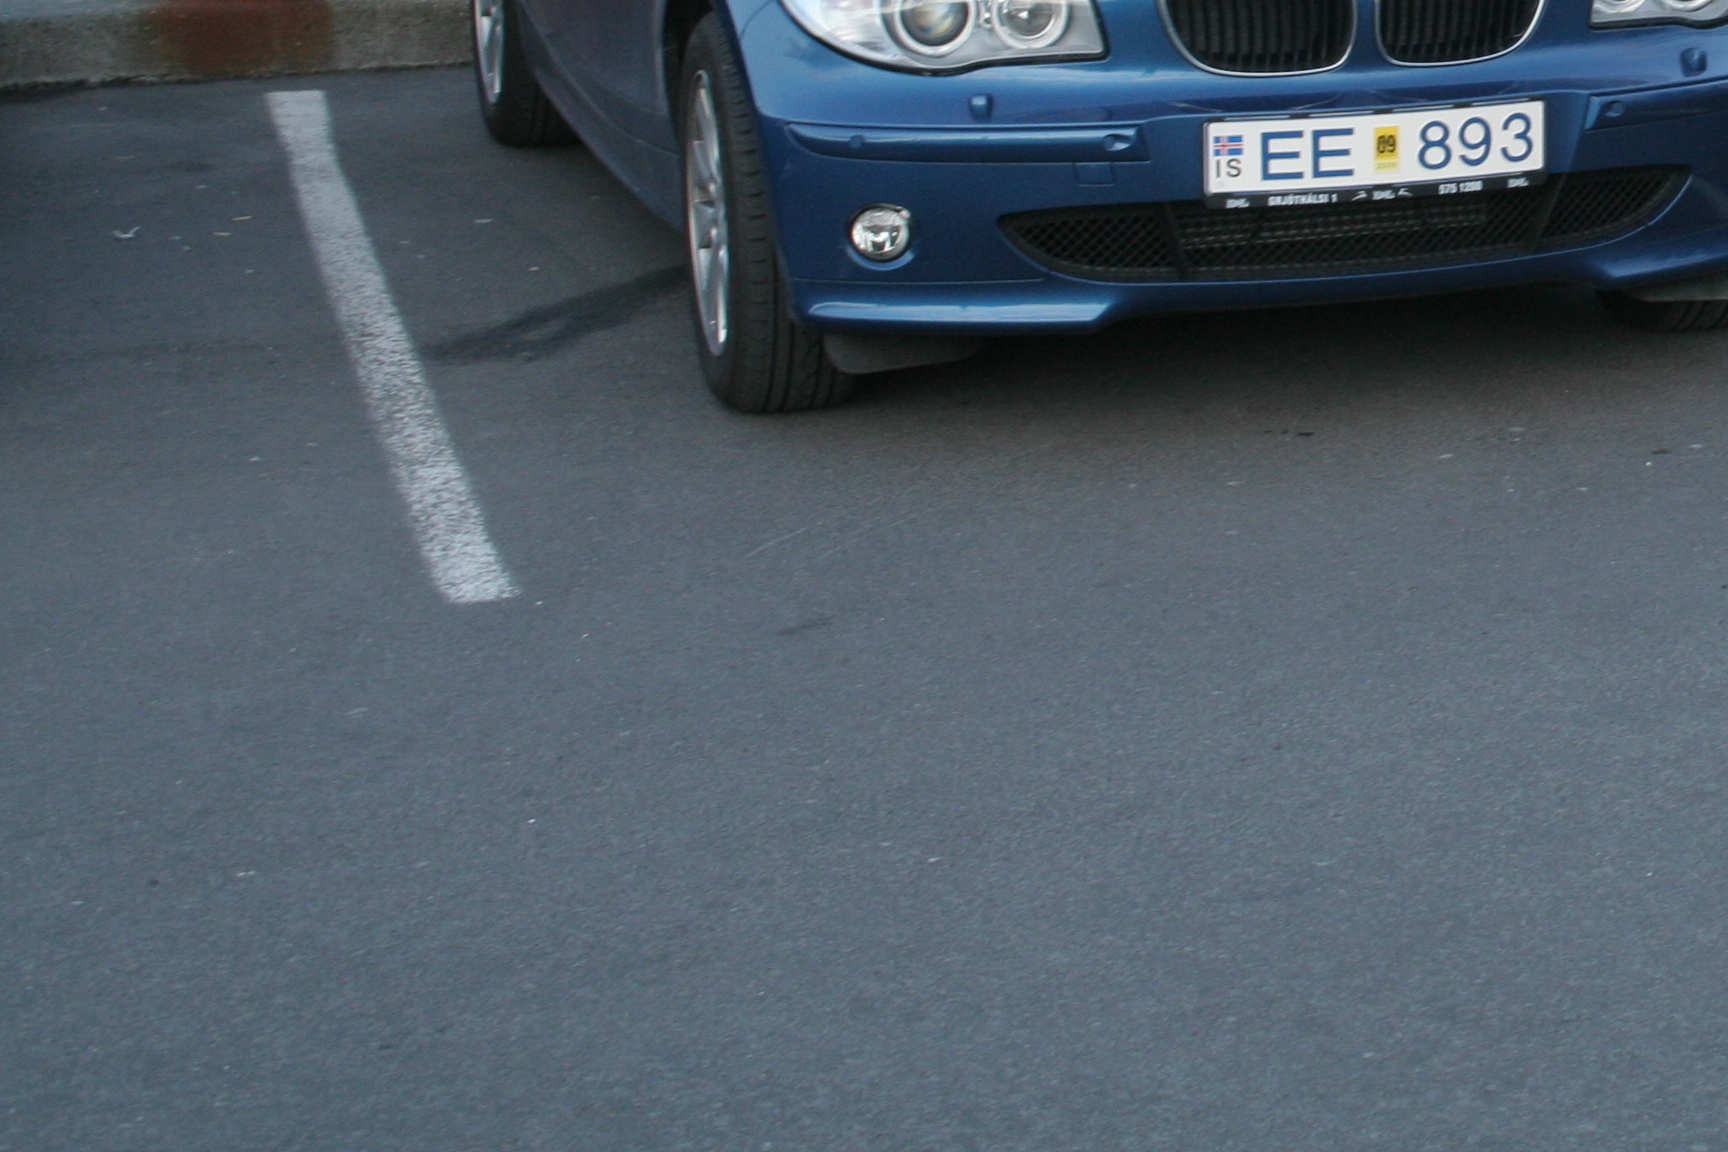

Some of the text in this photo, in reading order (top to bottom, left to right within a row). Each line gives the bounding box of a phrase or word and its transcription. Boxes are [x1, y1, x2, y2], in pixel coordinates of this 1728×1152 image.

[1214, 158, 1243, 179] IS
[1261, 112, 1533, 181] EE 893
